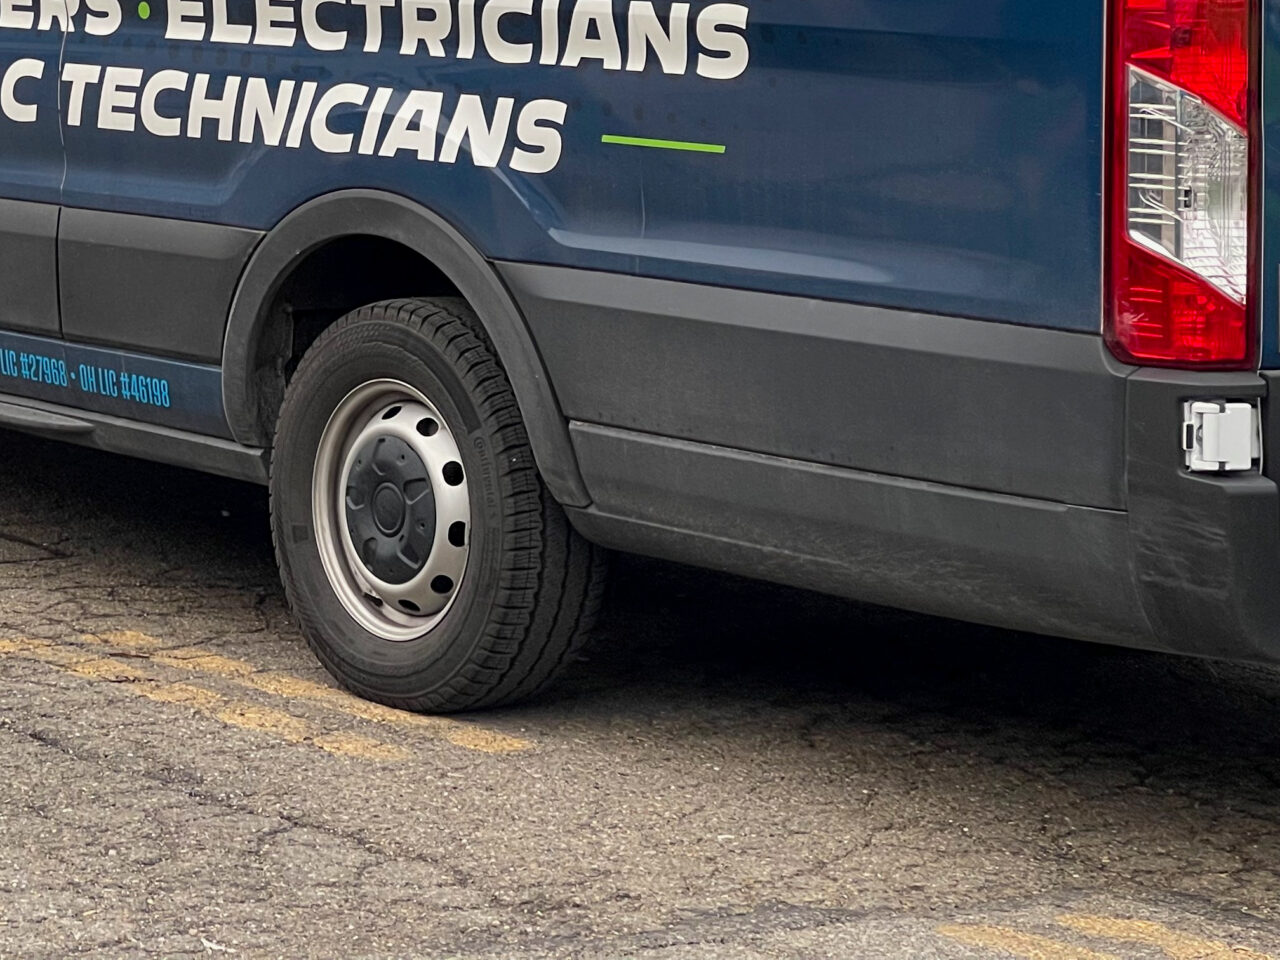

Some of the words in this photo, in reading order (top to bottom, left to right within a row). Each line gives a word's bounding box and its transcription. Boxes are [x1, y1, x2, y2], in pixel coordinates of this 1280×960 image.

[61, 62, 568, 173] TECHNICIANS
[0, 348, 18, 378] LIC
[20, 352, 68, 388] #27968
[79, 363, 97, 393] OH
[99, 366, 118, 399] LIC
[120, 373, 170, 408] #46198
